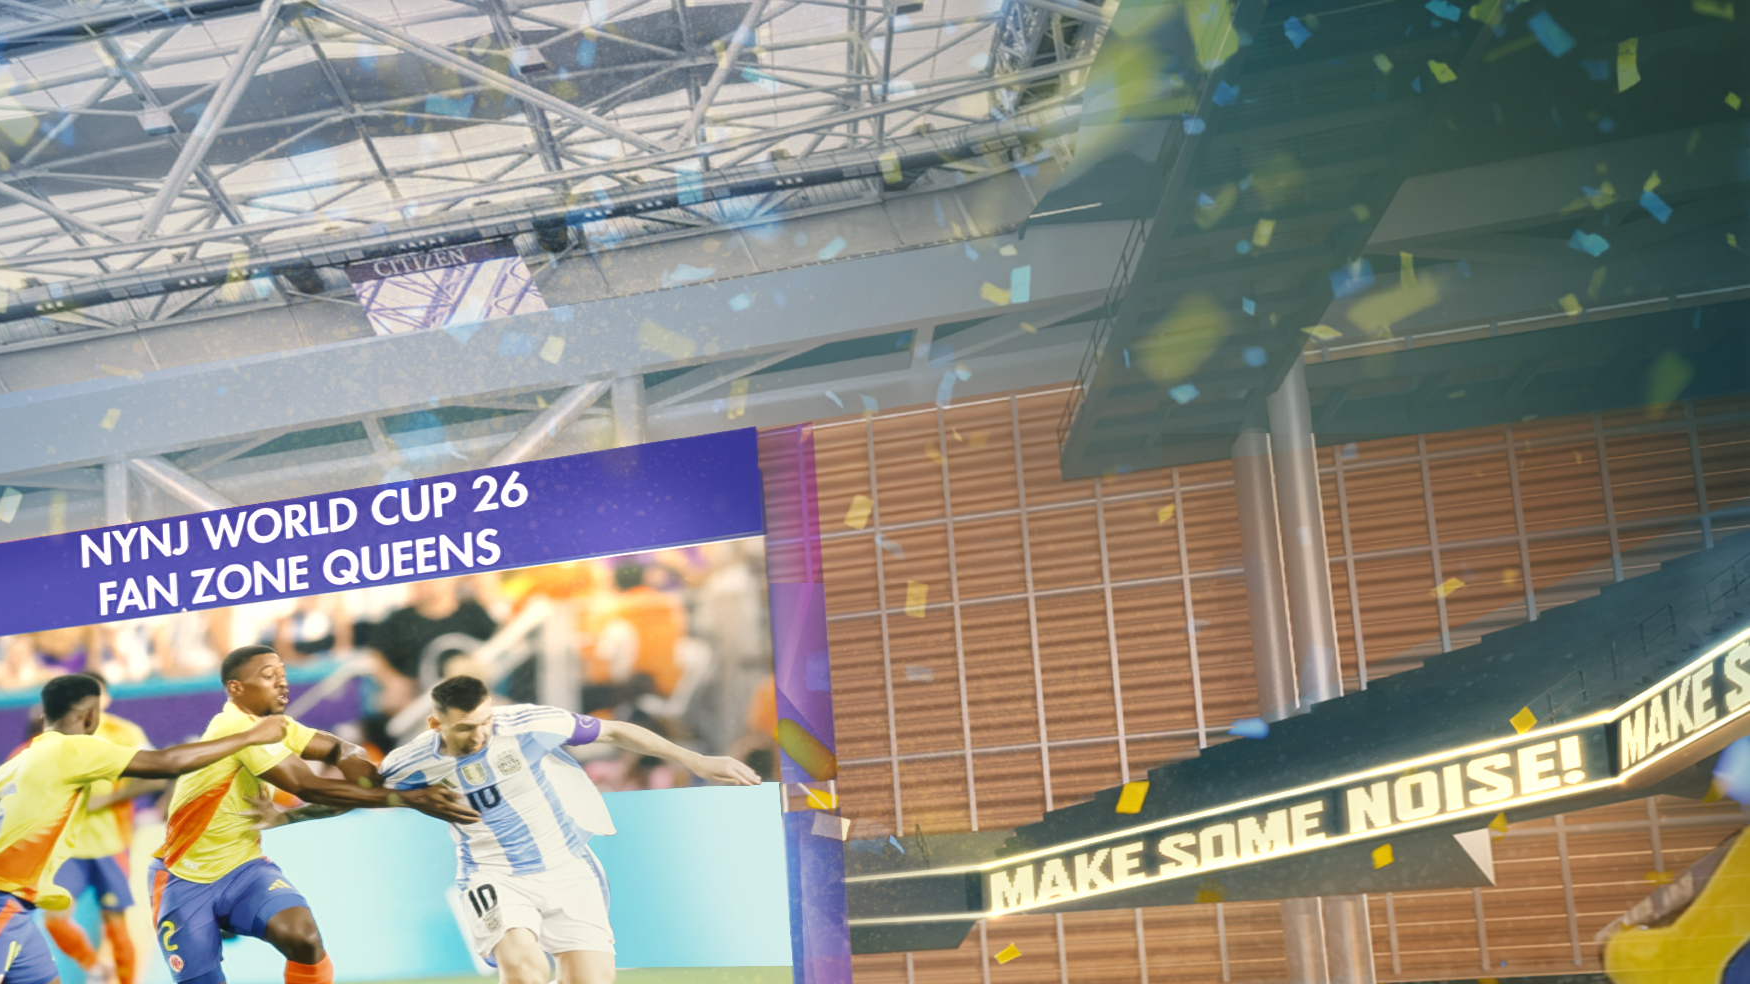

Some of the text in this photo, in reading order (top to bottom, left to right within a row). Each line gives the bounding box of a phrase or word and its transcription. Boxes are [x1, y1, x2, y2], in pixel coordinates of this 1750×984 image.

[373, 248, 467, 277] CITIZEN
[80, 471, 529, 568] NYNJ WORLD CUP 26
[98, 528, 501, 616] FAN ZONE QUEENS
[1621, 662, 1717, 770] MAKE
[466, 784, 502, 813] 10
[989, 735, 1585, 913] MAKE SOME NOISE!
[468, 884, 498, 918] 10
[161, 920, 178, 951] 2
